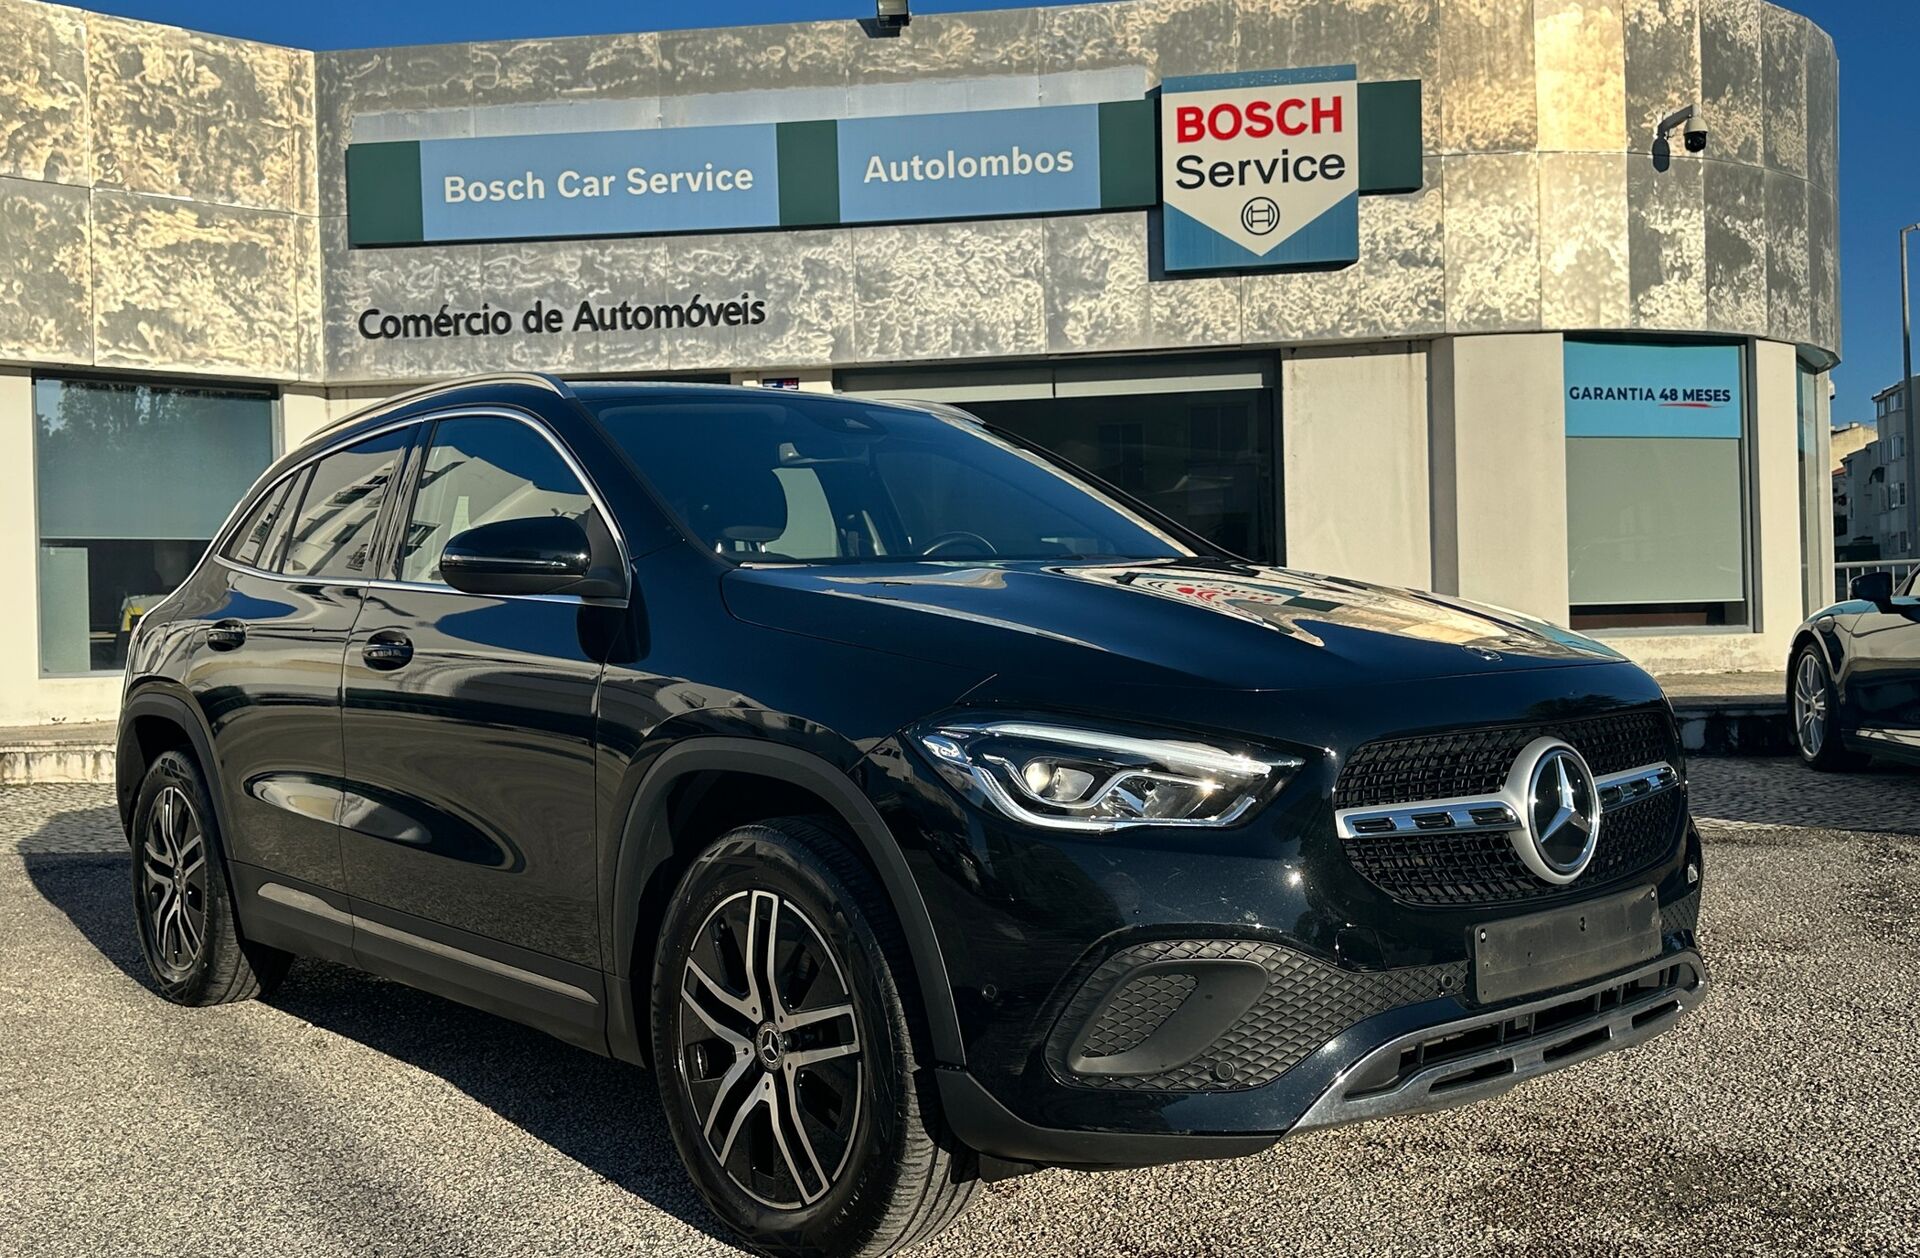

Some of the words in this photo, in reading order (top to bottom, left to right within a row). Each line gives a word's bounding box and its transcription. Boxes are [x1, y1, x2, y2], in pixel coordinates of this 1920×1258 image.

[1176, 96, 1343, 144] BOSCH
[444, 171, 546, 204] Bosch
[557, 168, 615, 198] Car
[627, 162, 754, 195] Service
[864, 146, 1074, 184] Autolombos
[1175, 149, 1345, 190] Service
[358, 303, 512, 340] Comércio
[522, 301, 563, 334] de
[573, 293, 766, 332] Automóveis
[1569, 386, 1655, 401] GARANTIA
[1659, 388, 1678, 401] 48
[1682, 388, 1731, 402] MESES
